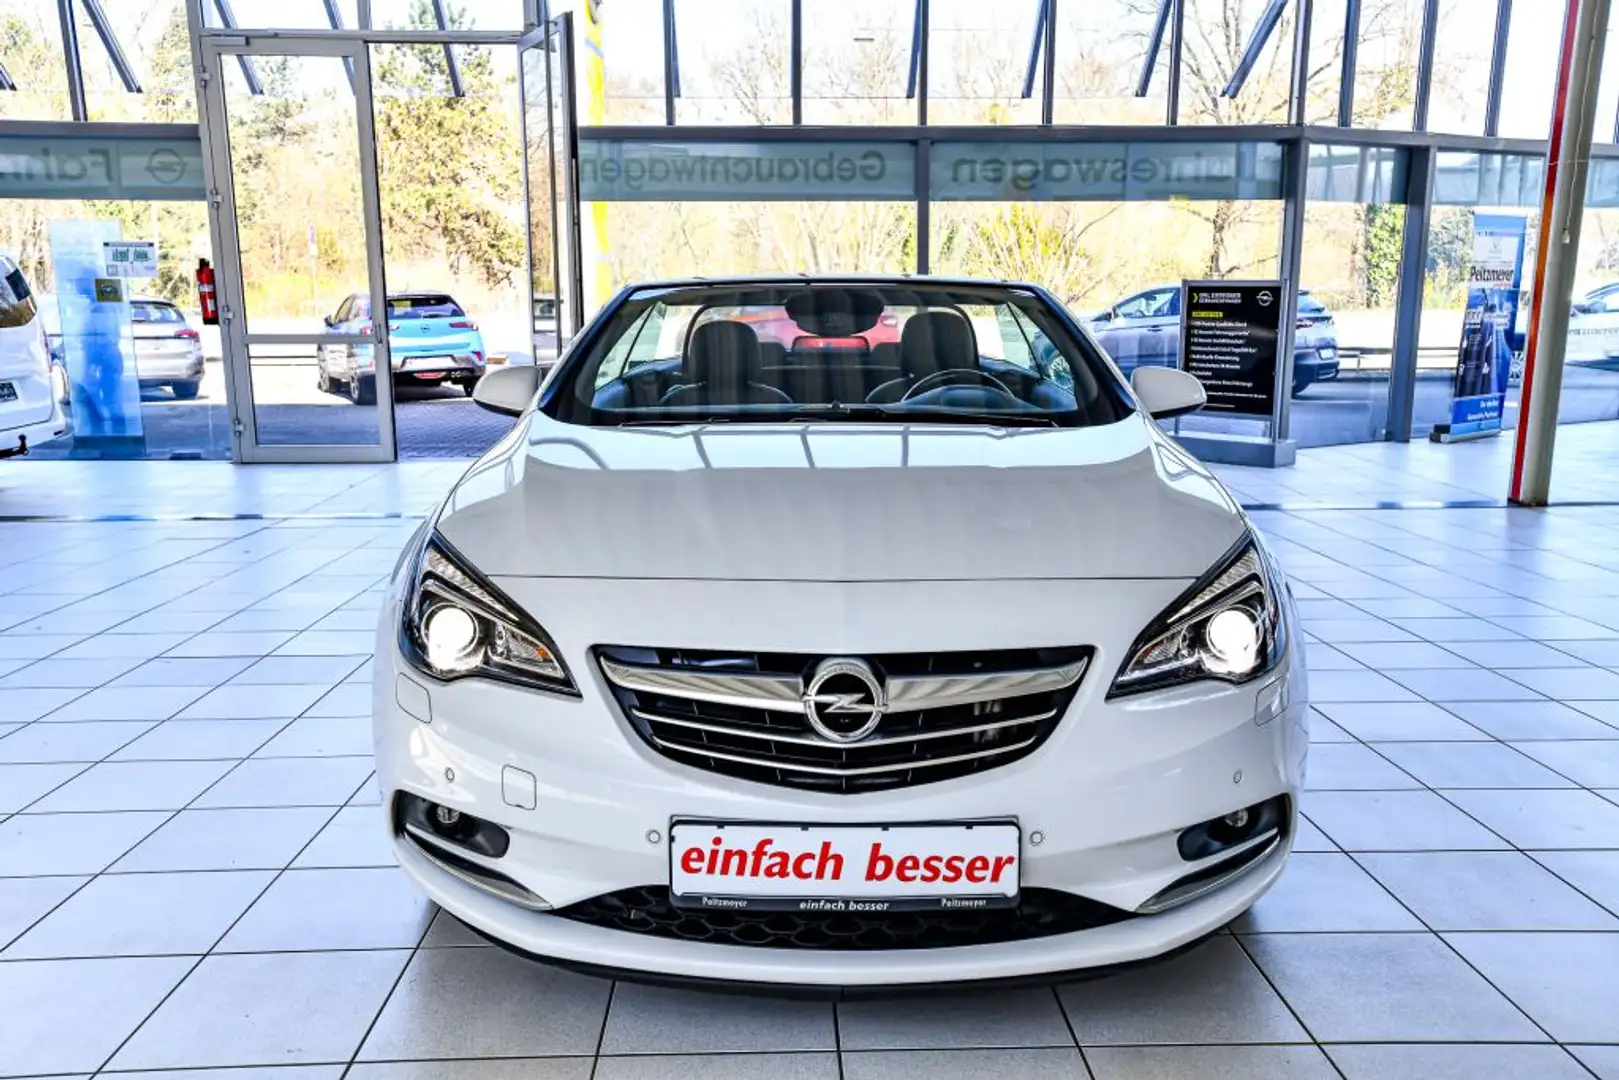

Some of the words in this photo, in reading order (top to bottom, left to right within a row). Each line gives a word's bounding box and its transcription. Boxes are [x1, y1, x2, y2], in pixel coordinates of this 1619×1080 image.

[681, 836, 844, 880] einfach
[865, 843, 1015, 883] besser
[799, 901, 846, 911] einfach
[849, 901, 890, 911] besser
